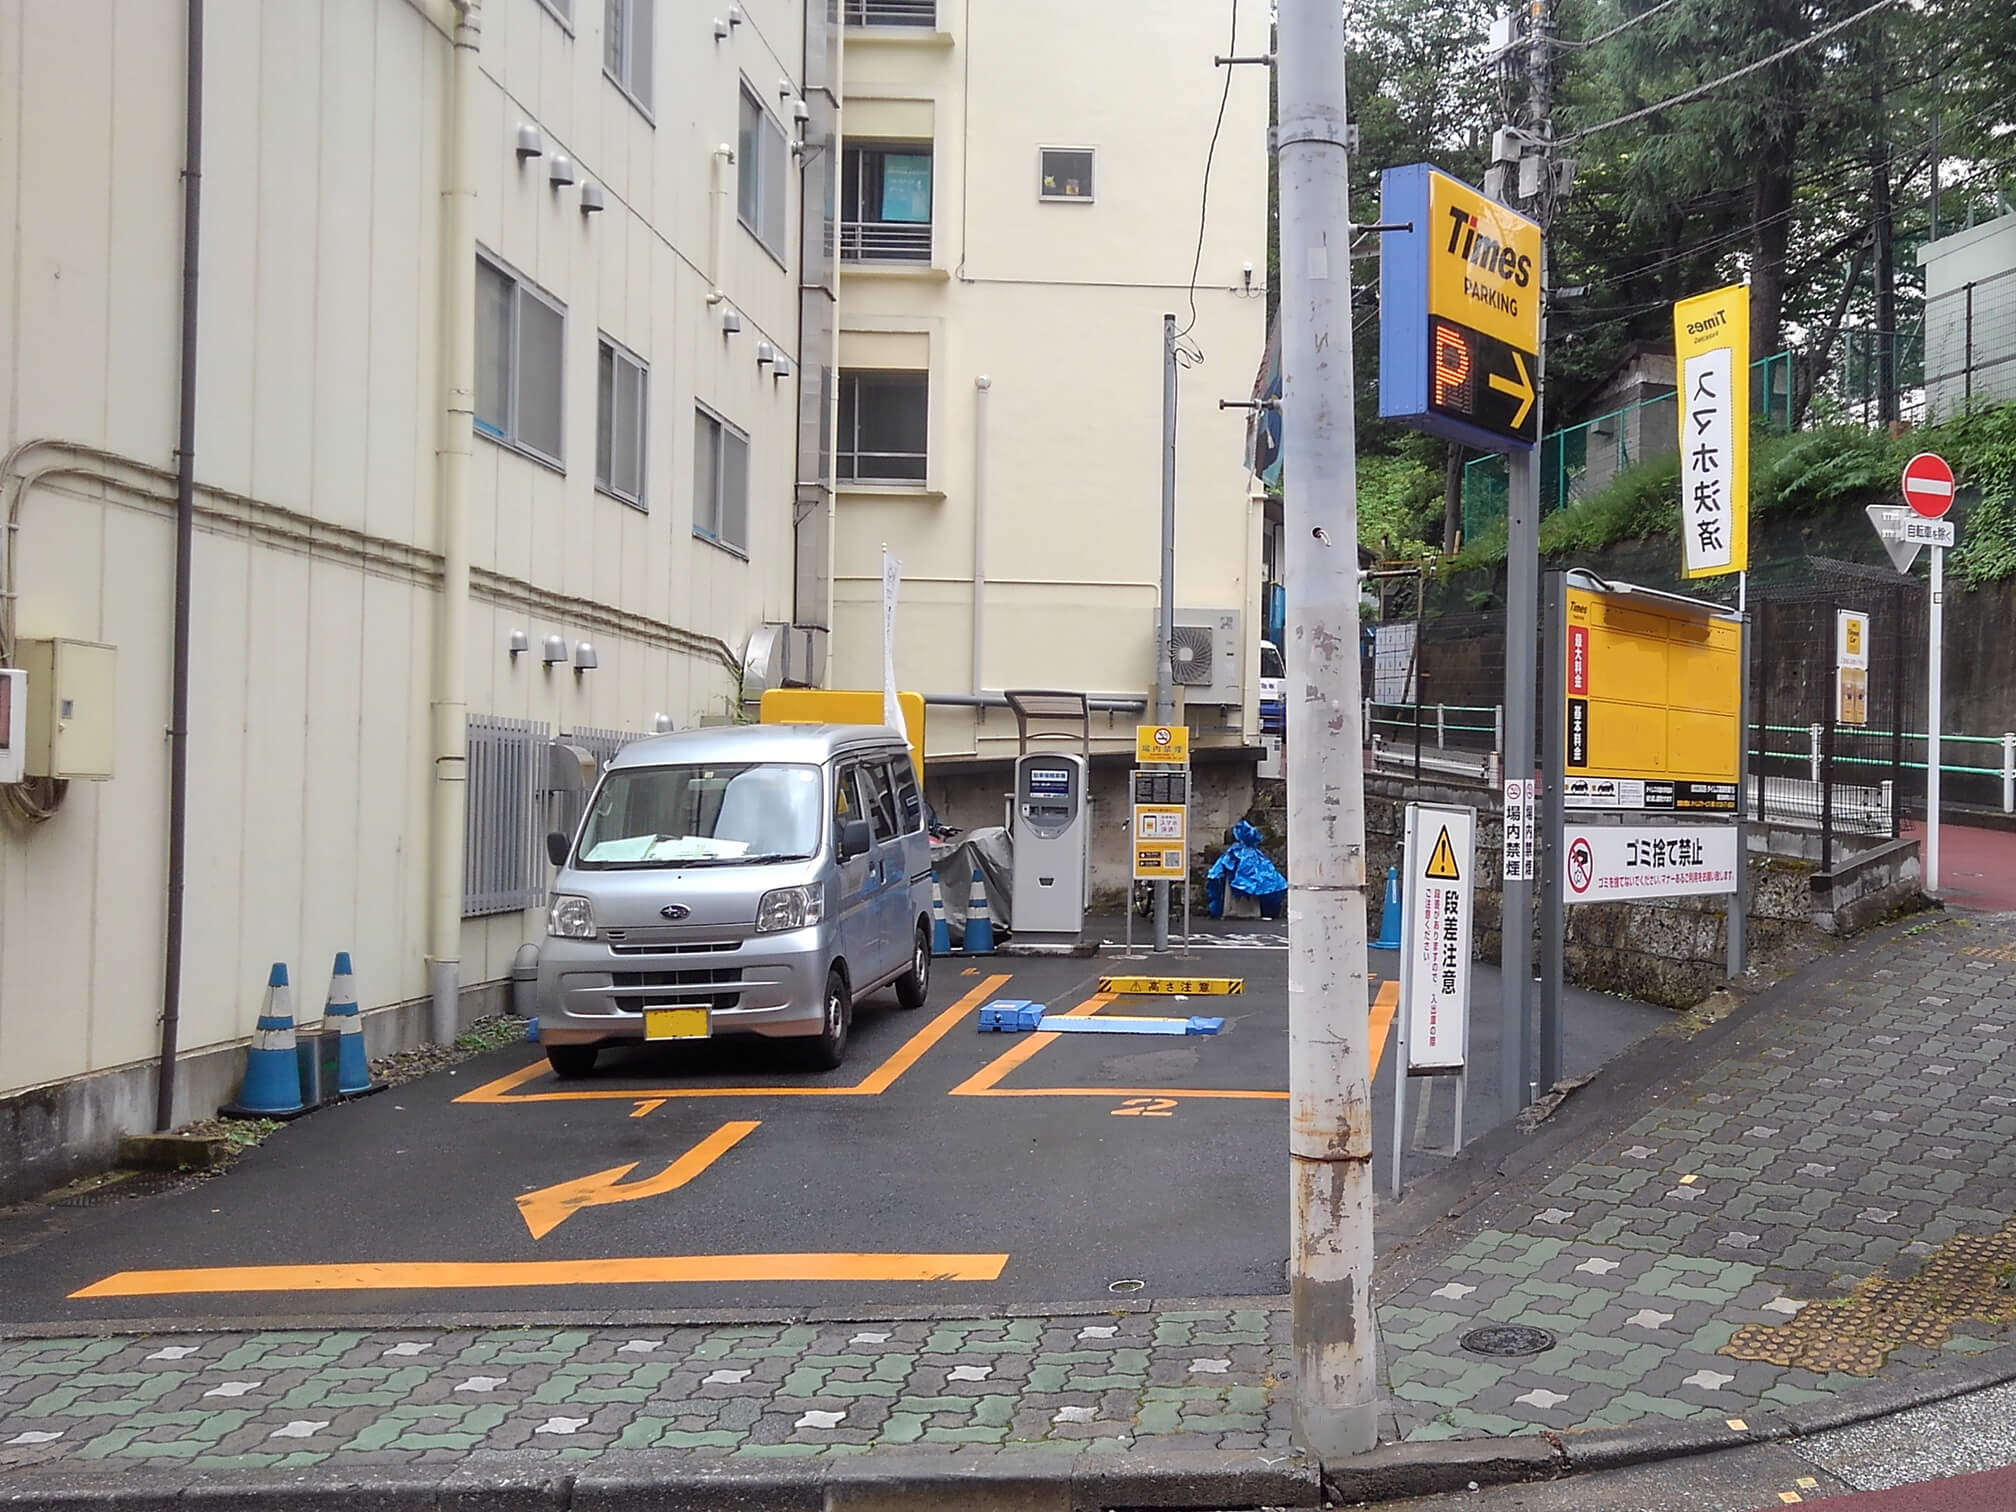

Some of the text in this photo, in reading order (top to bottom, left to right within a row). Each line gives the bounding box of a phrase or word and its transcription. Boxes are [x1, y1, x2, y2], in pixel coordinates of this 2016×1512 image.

[1447, 206, 1532, 288] Times
[1464, 277, 1518, 317] PARKING
[1435, 325, 1470, 406] P
[1907, 524, 1952, 541] 自転車を除く
[1506, 805, 1521, 876] 場内禁煙
[1626, 838, 1703, 868] ゴミ捨て禁止
[1441, 889, 1460, 994] 段差注意
[1148, 981, 1210, 993] 高さ注意
[1110, 1098, 1179, 1117] 2
